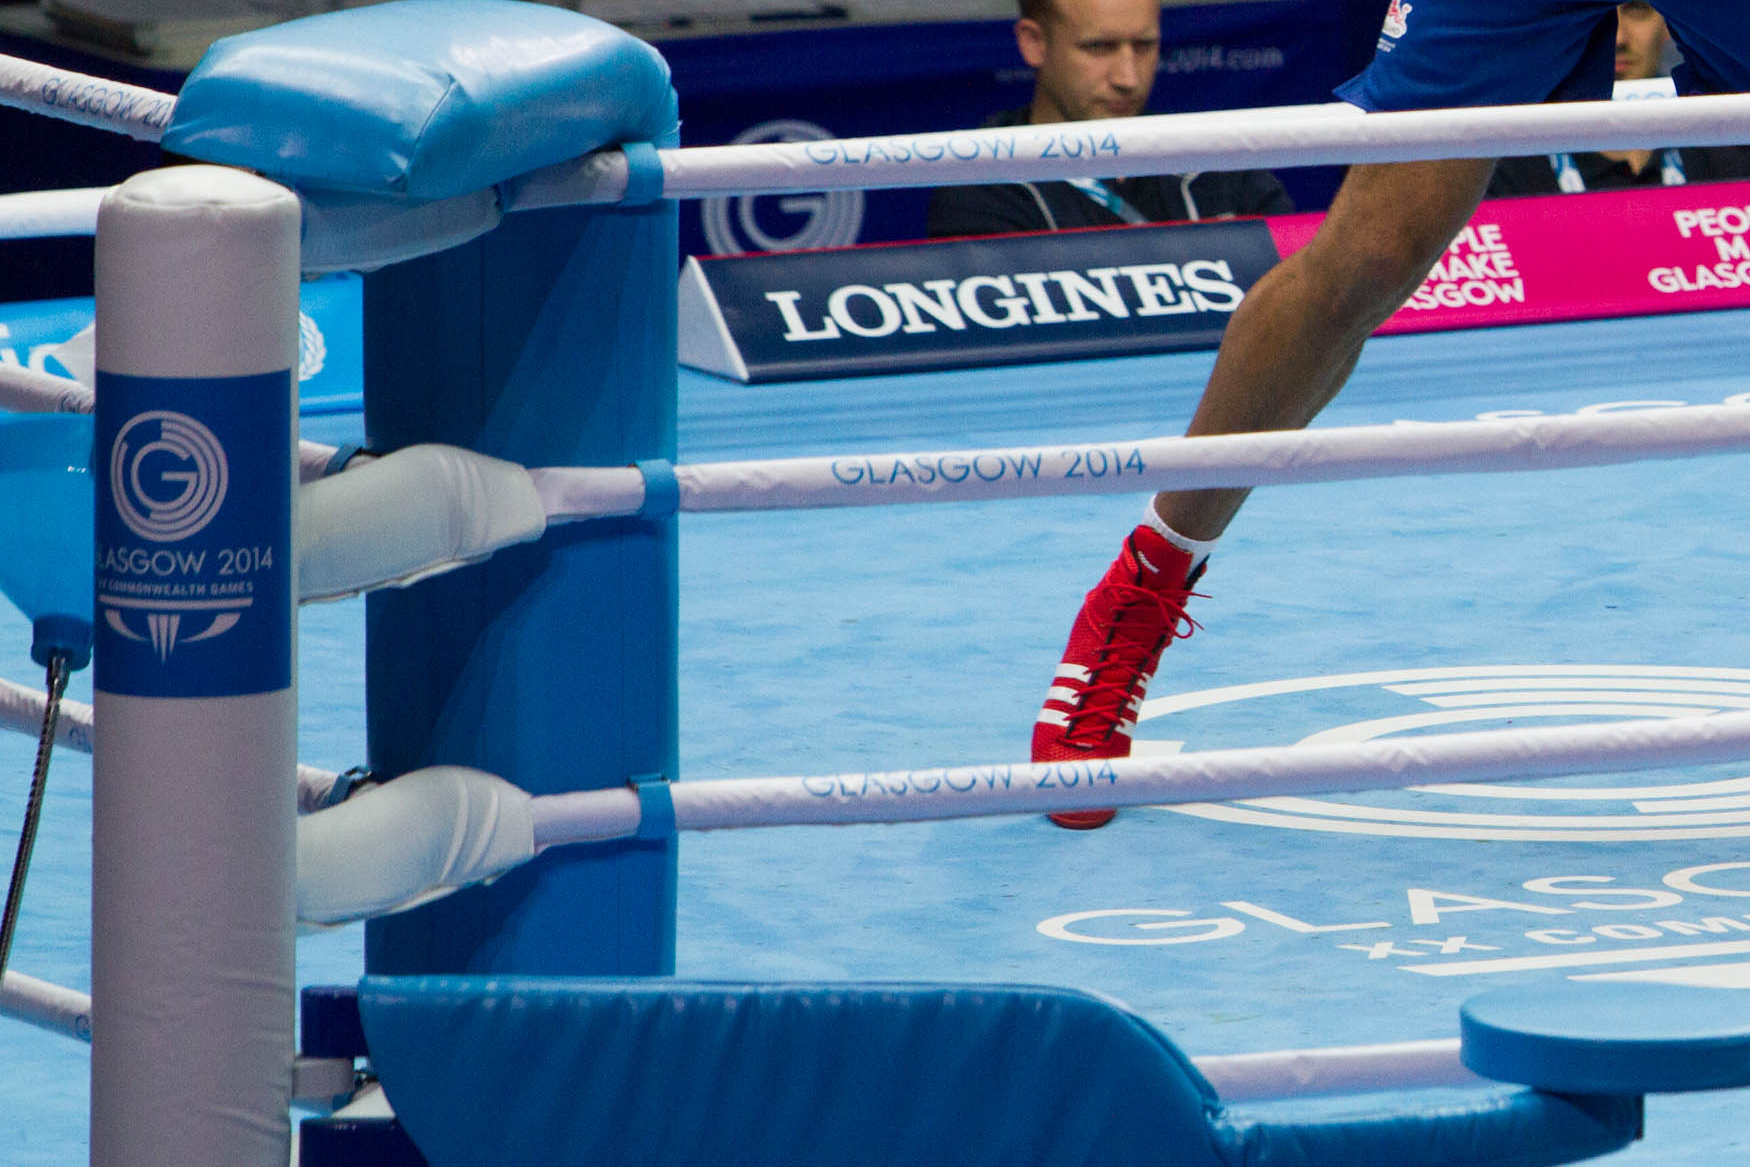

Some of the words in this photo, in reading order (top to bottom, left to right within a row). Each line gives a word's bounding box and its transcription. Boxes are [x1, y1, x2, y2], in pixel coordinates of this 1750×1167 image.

[804, 133, 1016, 166] GLASGOW
[1038, 132, 1121, 158] 2014
[766, 259, 1245, 342] LONGINES
[831, 452, 1042, 485] GLASGOW
[1059, 447, 1147, 479] 2014
[217, 545, 273, 575] 2014
[210, 580, 253, 595] GAMES
[802, 764, 1012, 797] GLASGOW
[1035, 760, 1119, 789] 2014
[1338, 933, 1502, 961] XX
